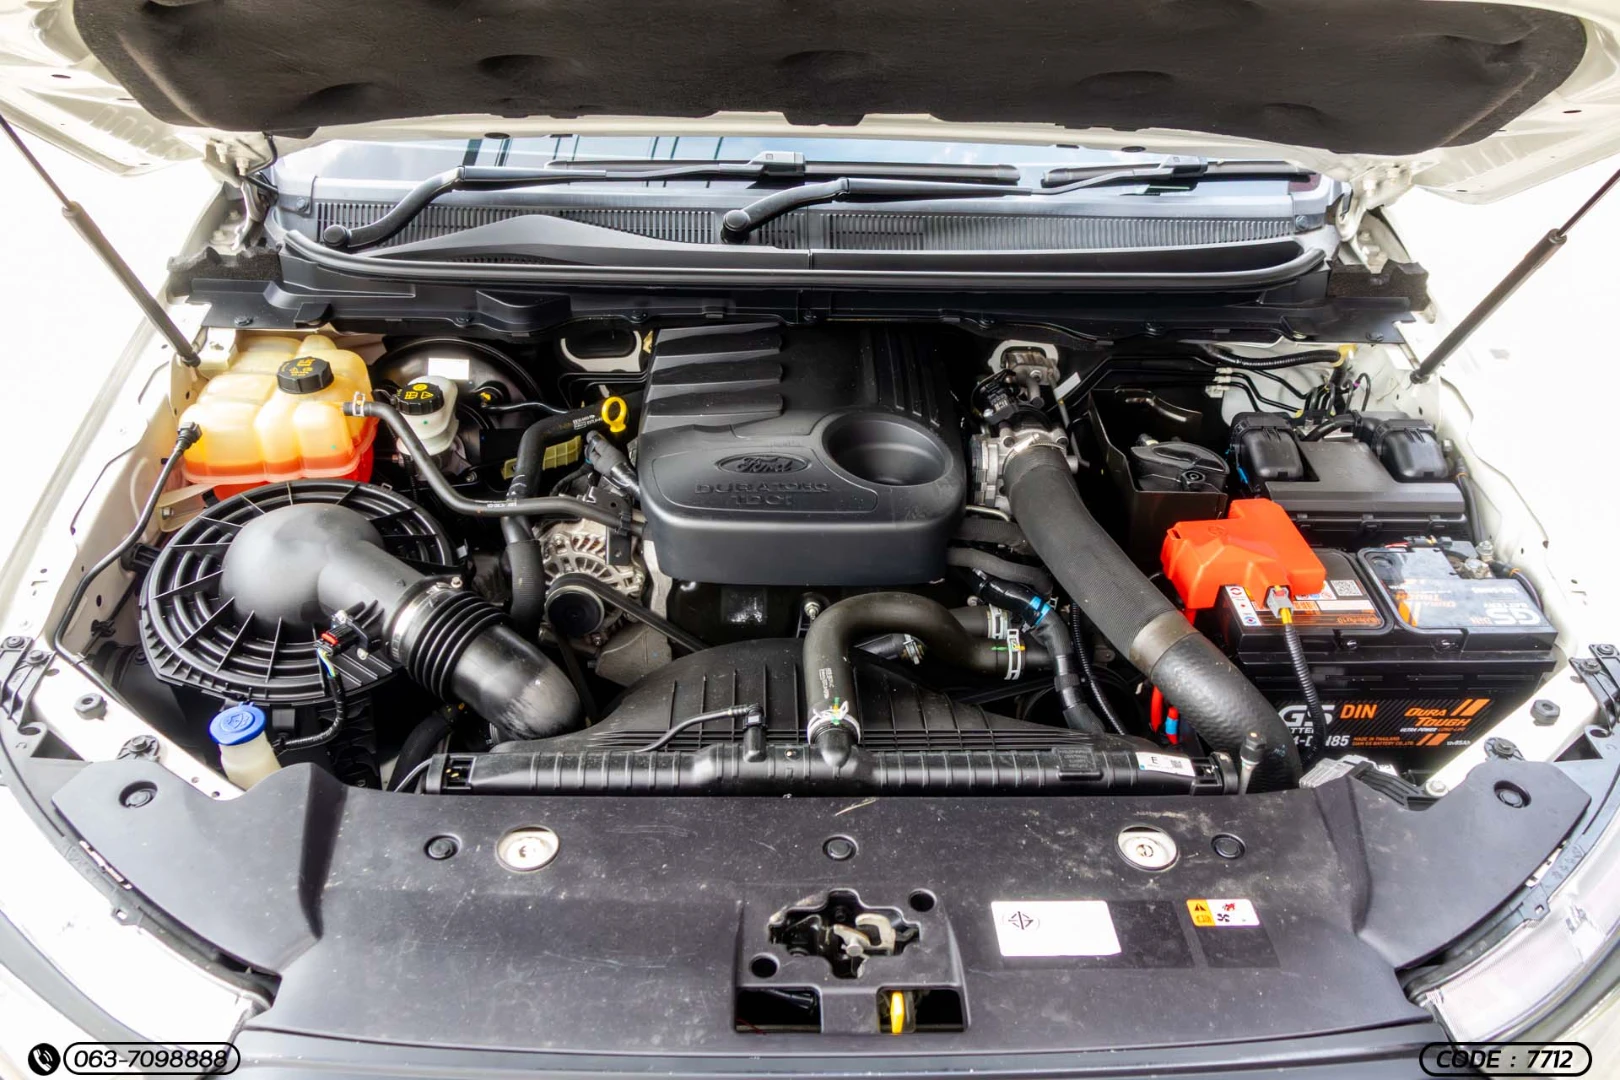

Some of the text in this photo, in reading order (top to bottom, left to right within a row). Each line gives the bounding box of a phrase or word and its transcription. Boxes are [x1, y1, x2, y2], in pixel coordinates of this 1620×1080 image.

[737, 456, 793, 473] Ford
[1485, 608, 1541, 625] GS
[1340, 704, 1378, 719] DIN
[1404, 707, 1448, 717] DURA
[1415, 717, 1472, 727] TOUGH
[1151, 756, 1159, 765] E
